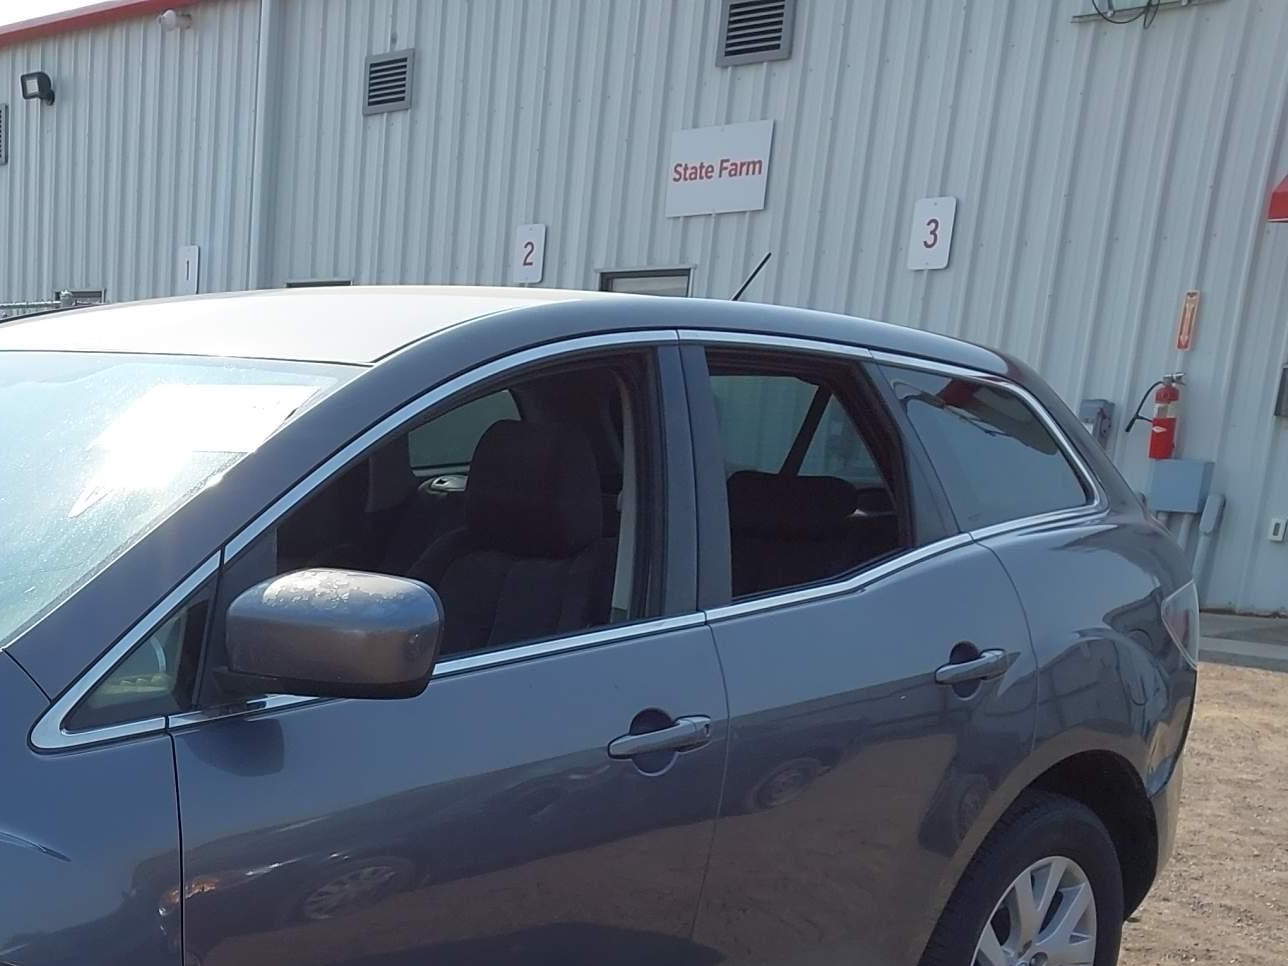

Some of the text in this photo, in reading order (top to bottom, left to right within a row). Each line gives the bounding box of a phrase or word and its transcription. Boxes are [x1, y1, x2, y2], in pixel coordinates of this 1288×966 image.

[672, 158, 763, 183] State Farm
[922, 218, 940, 249] 3
[522, 241, 535, 266] 2
